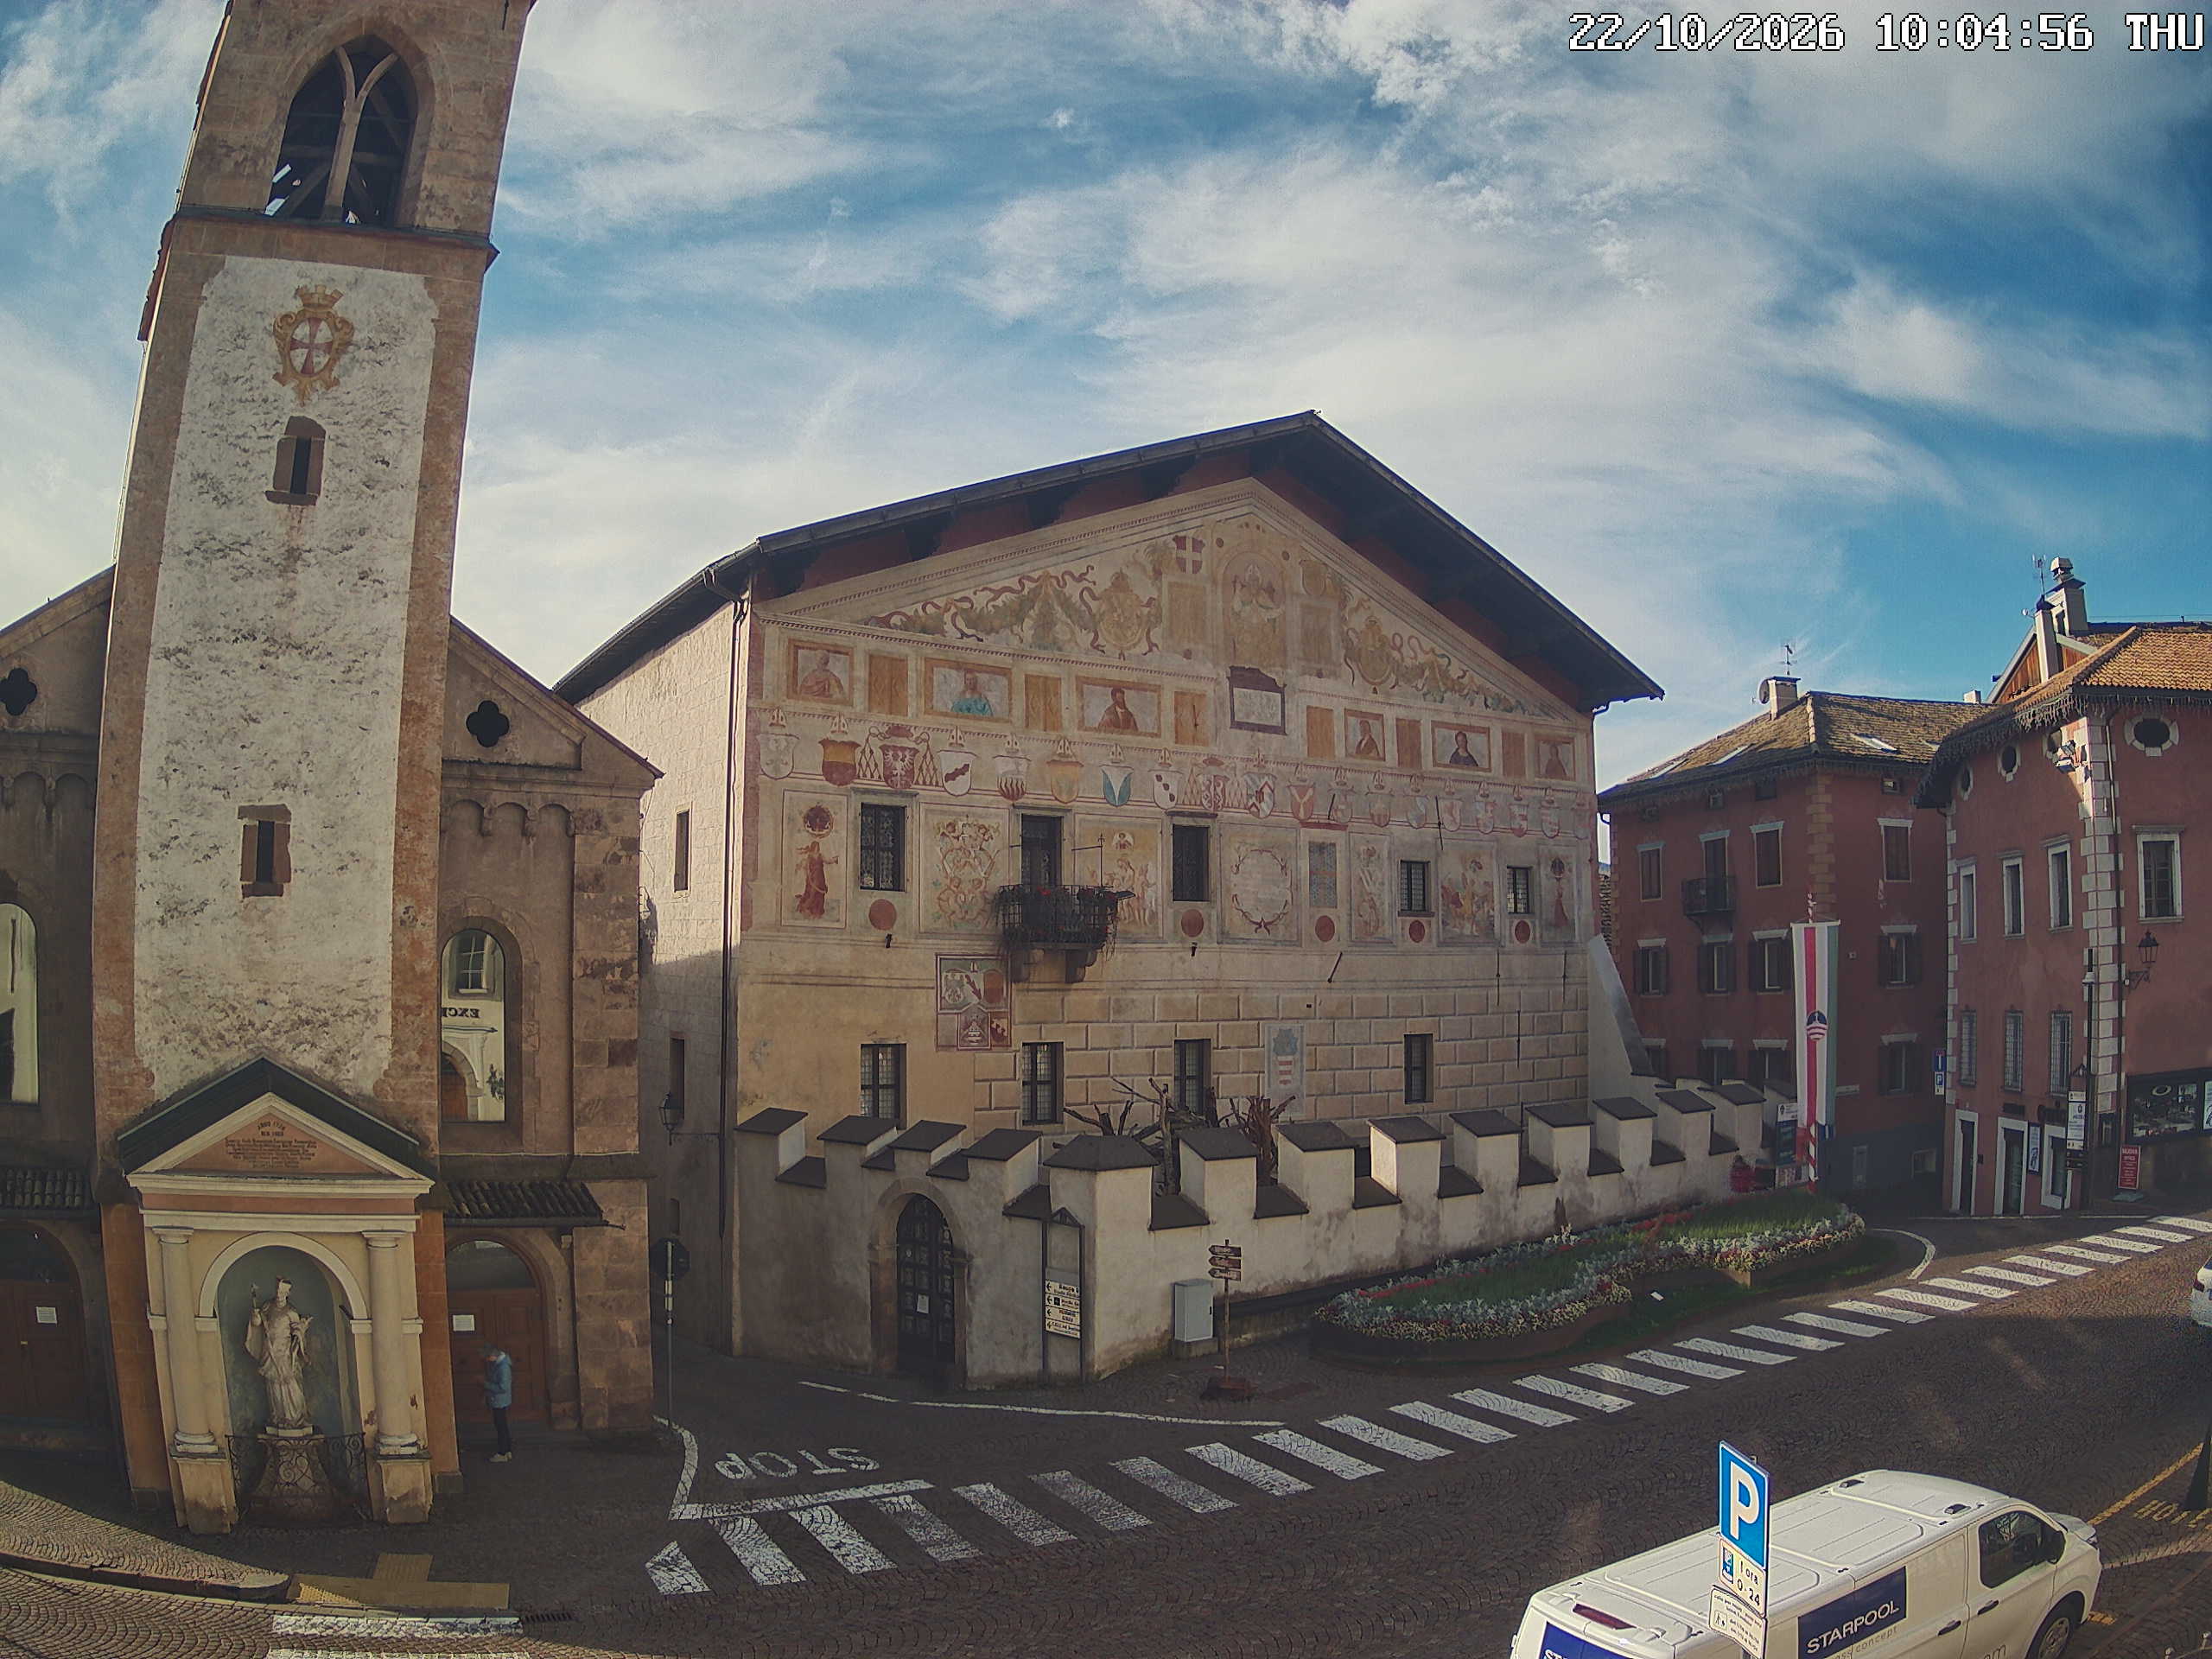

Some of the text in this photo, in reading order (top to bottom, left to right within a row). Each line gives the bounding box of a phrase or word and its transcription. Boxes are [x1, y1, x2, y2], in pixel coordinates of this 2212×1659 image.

[714, 1446, 880, 1480] STOP
[1730, 1459, 1761, 1541] P
[1745, 1568, 1759, 1586] ora
[1806, 1599, 1902, 1655] STARPOOL
[1855, 1626, 1898, 1654] concept
